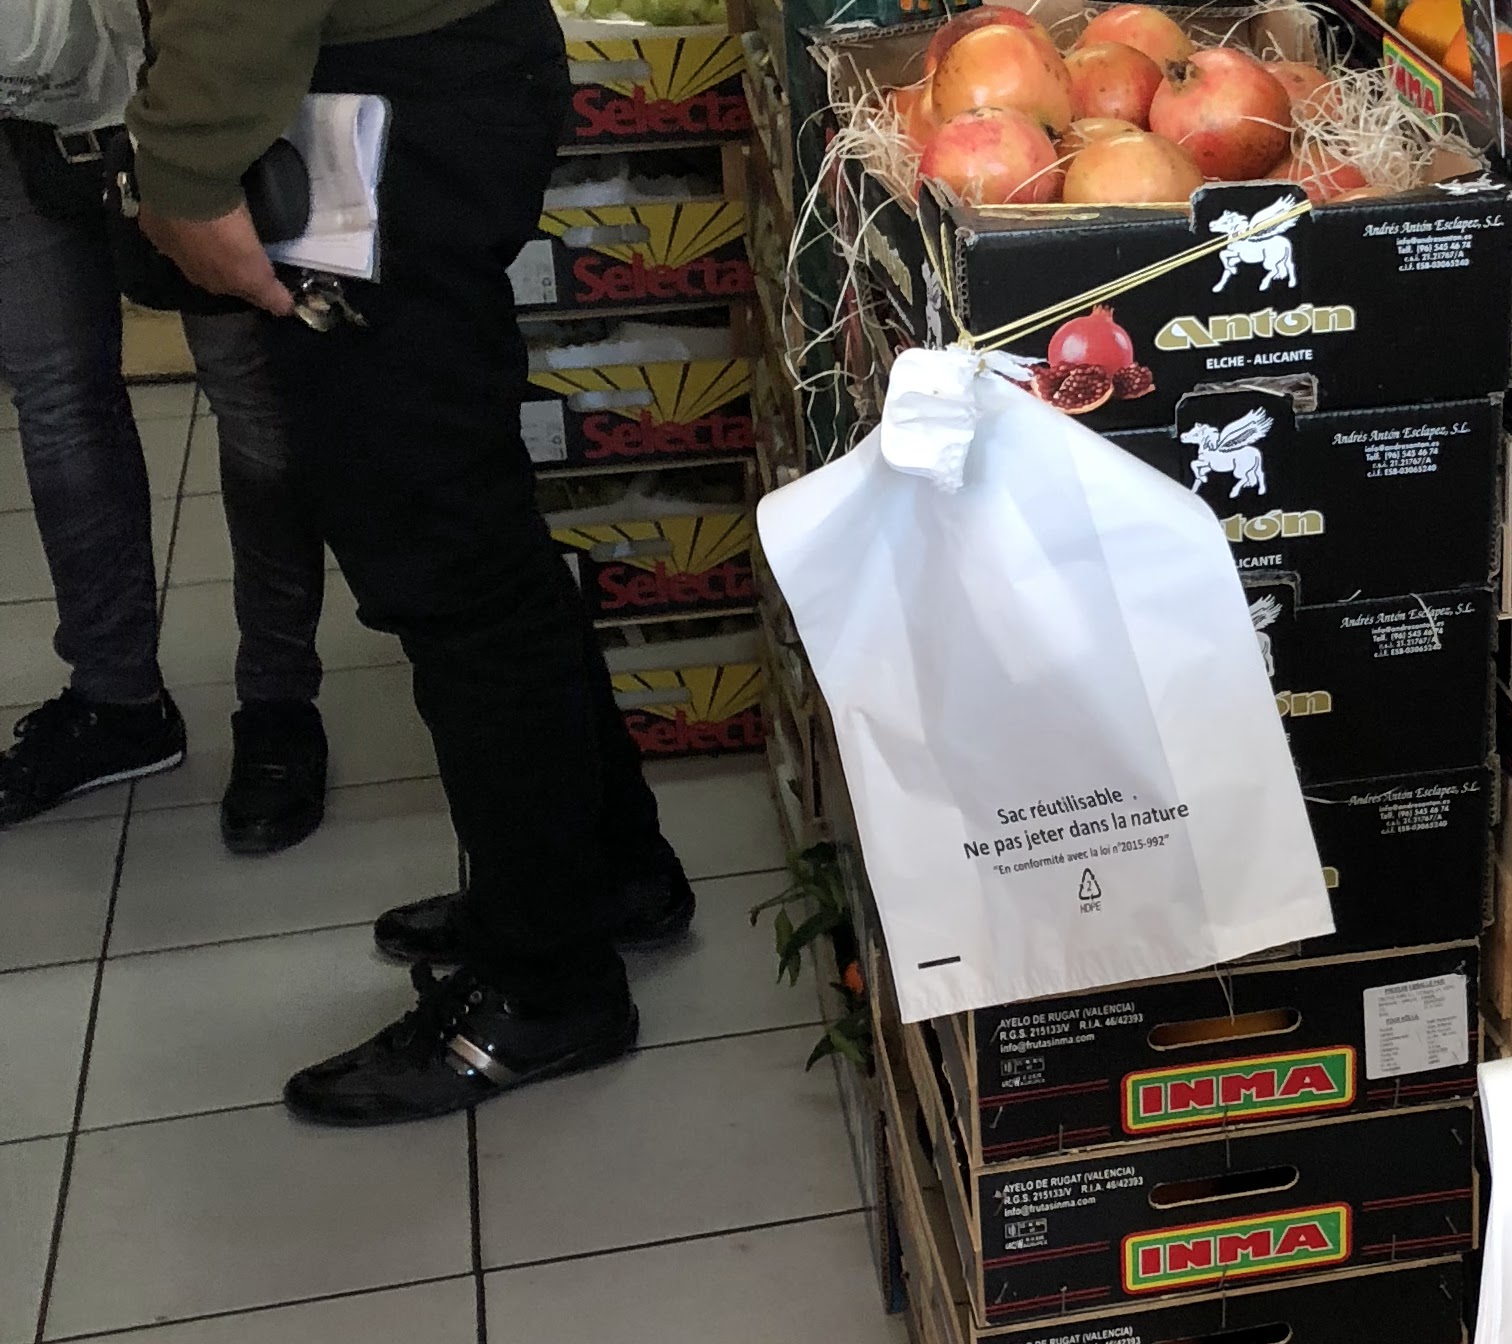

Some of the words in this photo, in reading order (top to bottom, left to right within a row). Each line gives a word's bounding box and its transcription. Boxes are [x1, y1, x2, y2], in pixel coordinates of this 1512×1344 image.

[571, 84, 753, 138] Selecta
[1363, 222, 1400, 237] Andrés
[1400, 219, 1432, 234] Antón
[572, 254, 755, 303] Selecta
[1155, 302, 1357, 353] Antón
[1206, 353, 1245, 370] ELCHE
[1253, 348, 1314, 367] ALICANTE
[581, 409, 755, 458] Selecta
[1332, 430, 1368, 446] Andrés
[1368, 428, 1400, 443] Antón
[1224, 508, 1326, 542] tón
[1236, 554, 1283, 569] LICANTE
[997, 807, 1027, 826] Sac
[1030, 786, 1124, 821] réutilisable
[963, 840, 991, 859] Ne
[994, 835, 1023, 857] pas
[1024, 827, 1065, 851] jeter
[1069, 815, 1111, 838] dans
[1112, 811, 1128, 831] la
[1130, 802, 1190, 828] nature
[1013, 851, 1066, 872] conformité
[1067, 849, 1089, 862] avec
[1089, 846, 1099, 858] la
[1099, 844, 1112, 857] loi
[1000, 1015, 1031, 1029] AYELO
[1032, 1013, 1046, 1024] DE
[1047, 1008, 1081, 1022] RUGAT
[1082, 1001, 1136, 1019] (VALENCIA)
[1000, 1033, 1095, 1054] info@frutasinma.com
[1030, 1023, 1070, 1037] 215133/V
[1138, 1063, 1338, 1118] INMA
[1003, 1181, 1034, 1194] AYELO
[1035, 1178, 1049, 1189] DE
[1050, 1173, 1082, 1187] RUGAT
[1084, 1166, 1136, 1184] (VALENCIA)
[1138, 1222, 1334, 1276] INMA
[1082, 1325, 1133, 1344] (VALENCIA)
